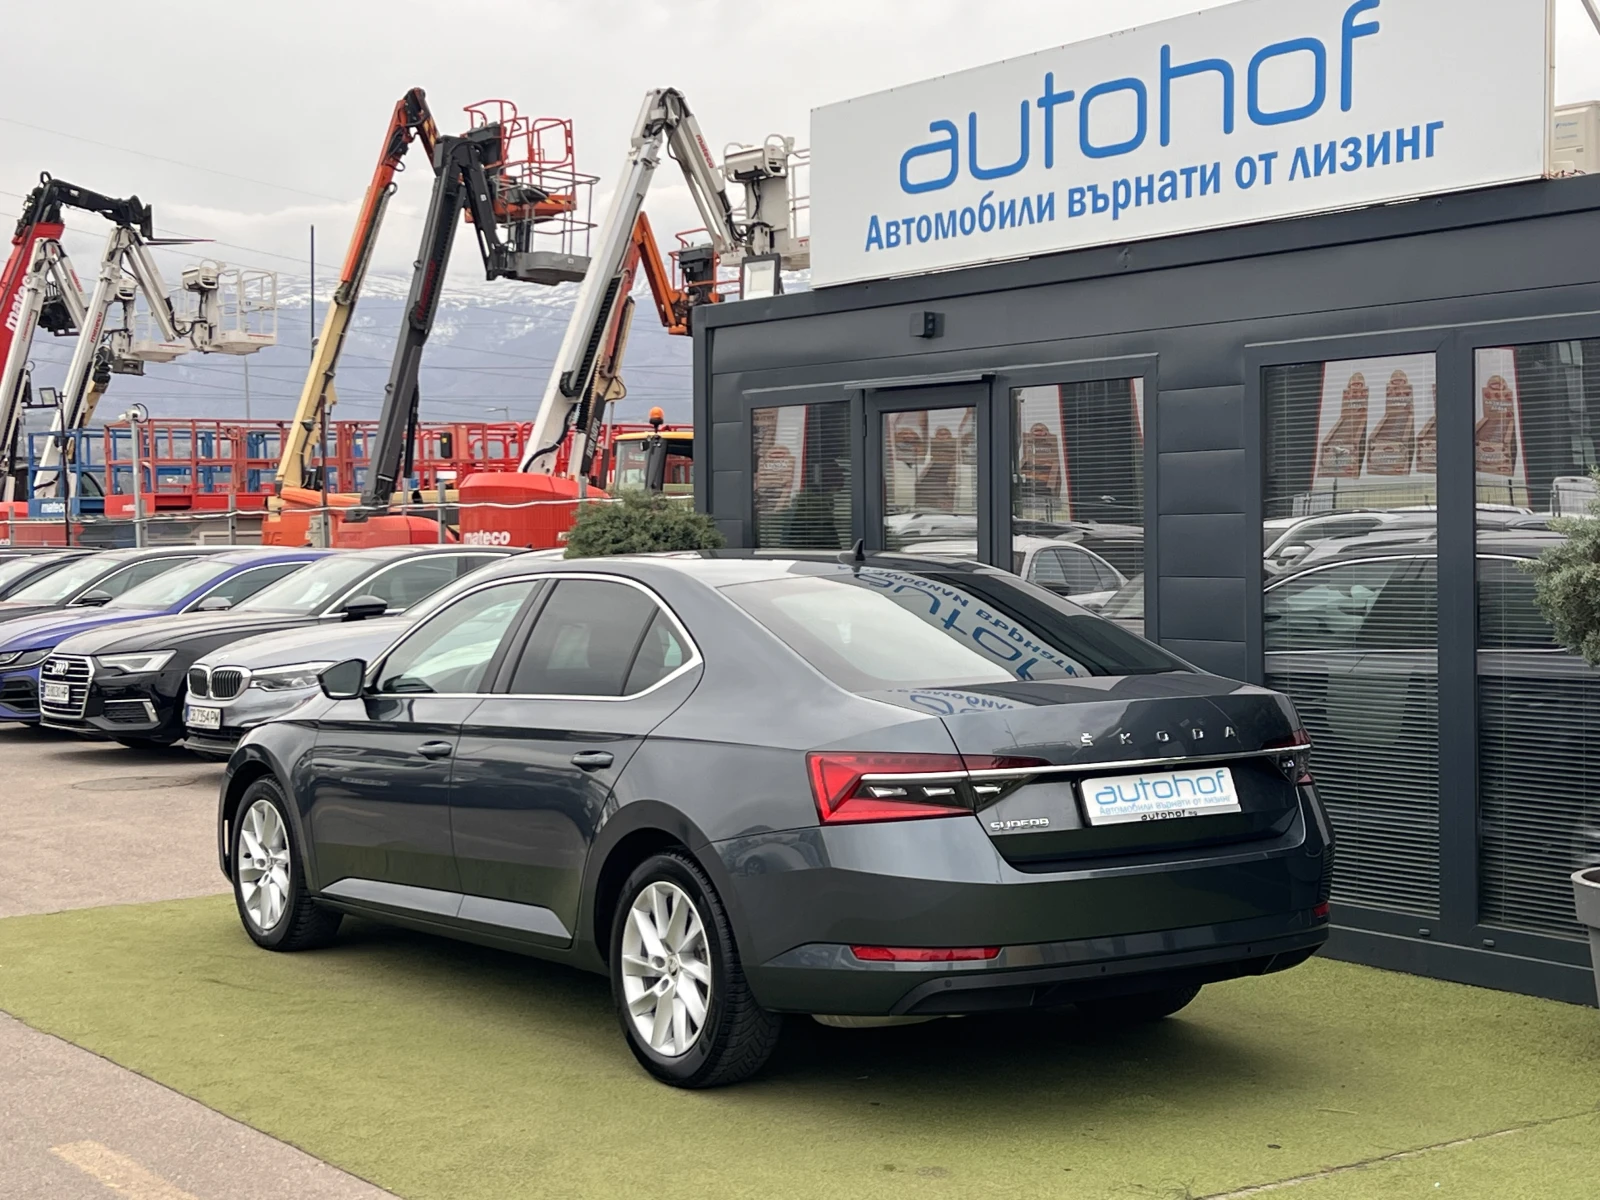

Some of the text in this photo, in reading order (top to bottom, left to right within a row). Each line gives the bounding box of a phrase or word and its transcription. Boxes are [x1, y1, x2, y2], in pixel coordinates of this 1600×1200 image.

[900, 0, 1380, 194] autohof
[866, 120, 1444, 251] Автомобили върнати от лизинг
[41, 500, 66, 513] matec
[463, 529, 511, 545] mateco
[1080, 726, 1237, 747] ŠKODA
[1095, 770, 1225, 805] autohof
[1099, 795, 1231, 815] Автомобили върнати от лизинг
[990, 817, 1050, 832] SUPERB
